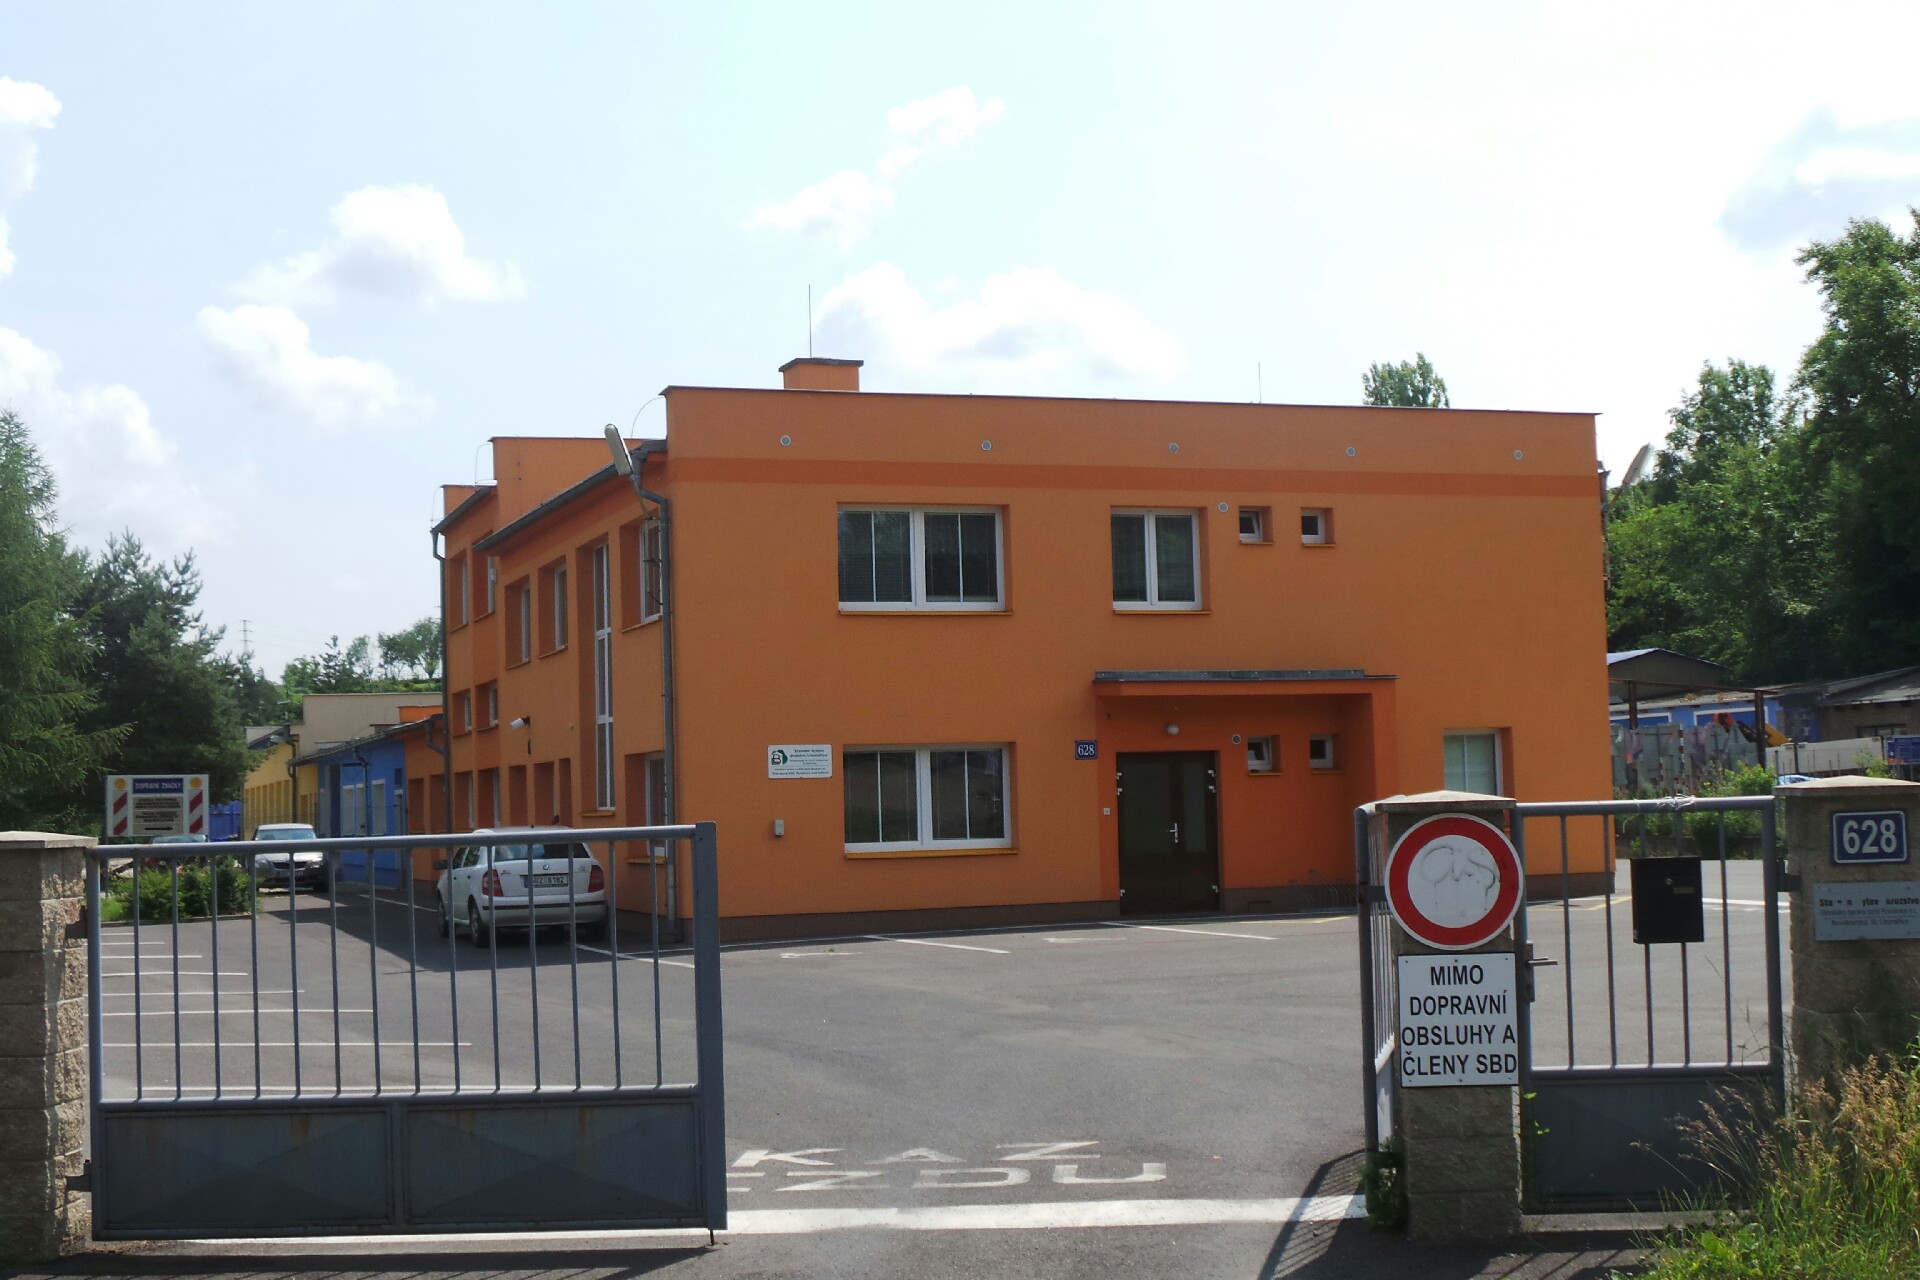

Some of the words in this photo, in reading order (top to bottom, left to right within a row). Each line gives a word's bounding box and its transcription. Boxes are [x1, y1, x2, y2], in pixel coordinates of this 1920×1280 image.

[1078, 744, 1095, 756] 628
[1843, 819, 1897, 854] 628
[1430, 965, 1483, 985] MIMO
[1410, 989, 1507, 1015] DOPRAVNÍ
[1402, 1024, 1495, 1046] OBSLUHY
[1502, 1024, 1516, 1044] A
[1402, 1050, 1469, 1076] ČLENY
[1476, 1053, 1517, 1074] SBD
